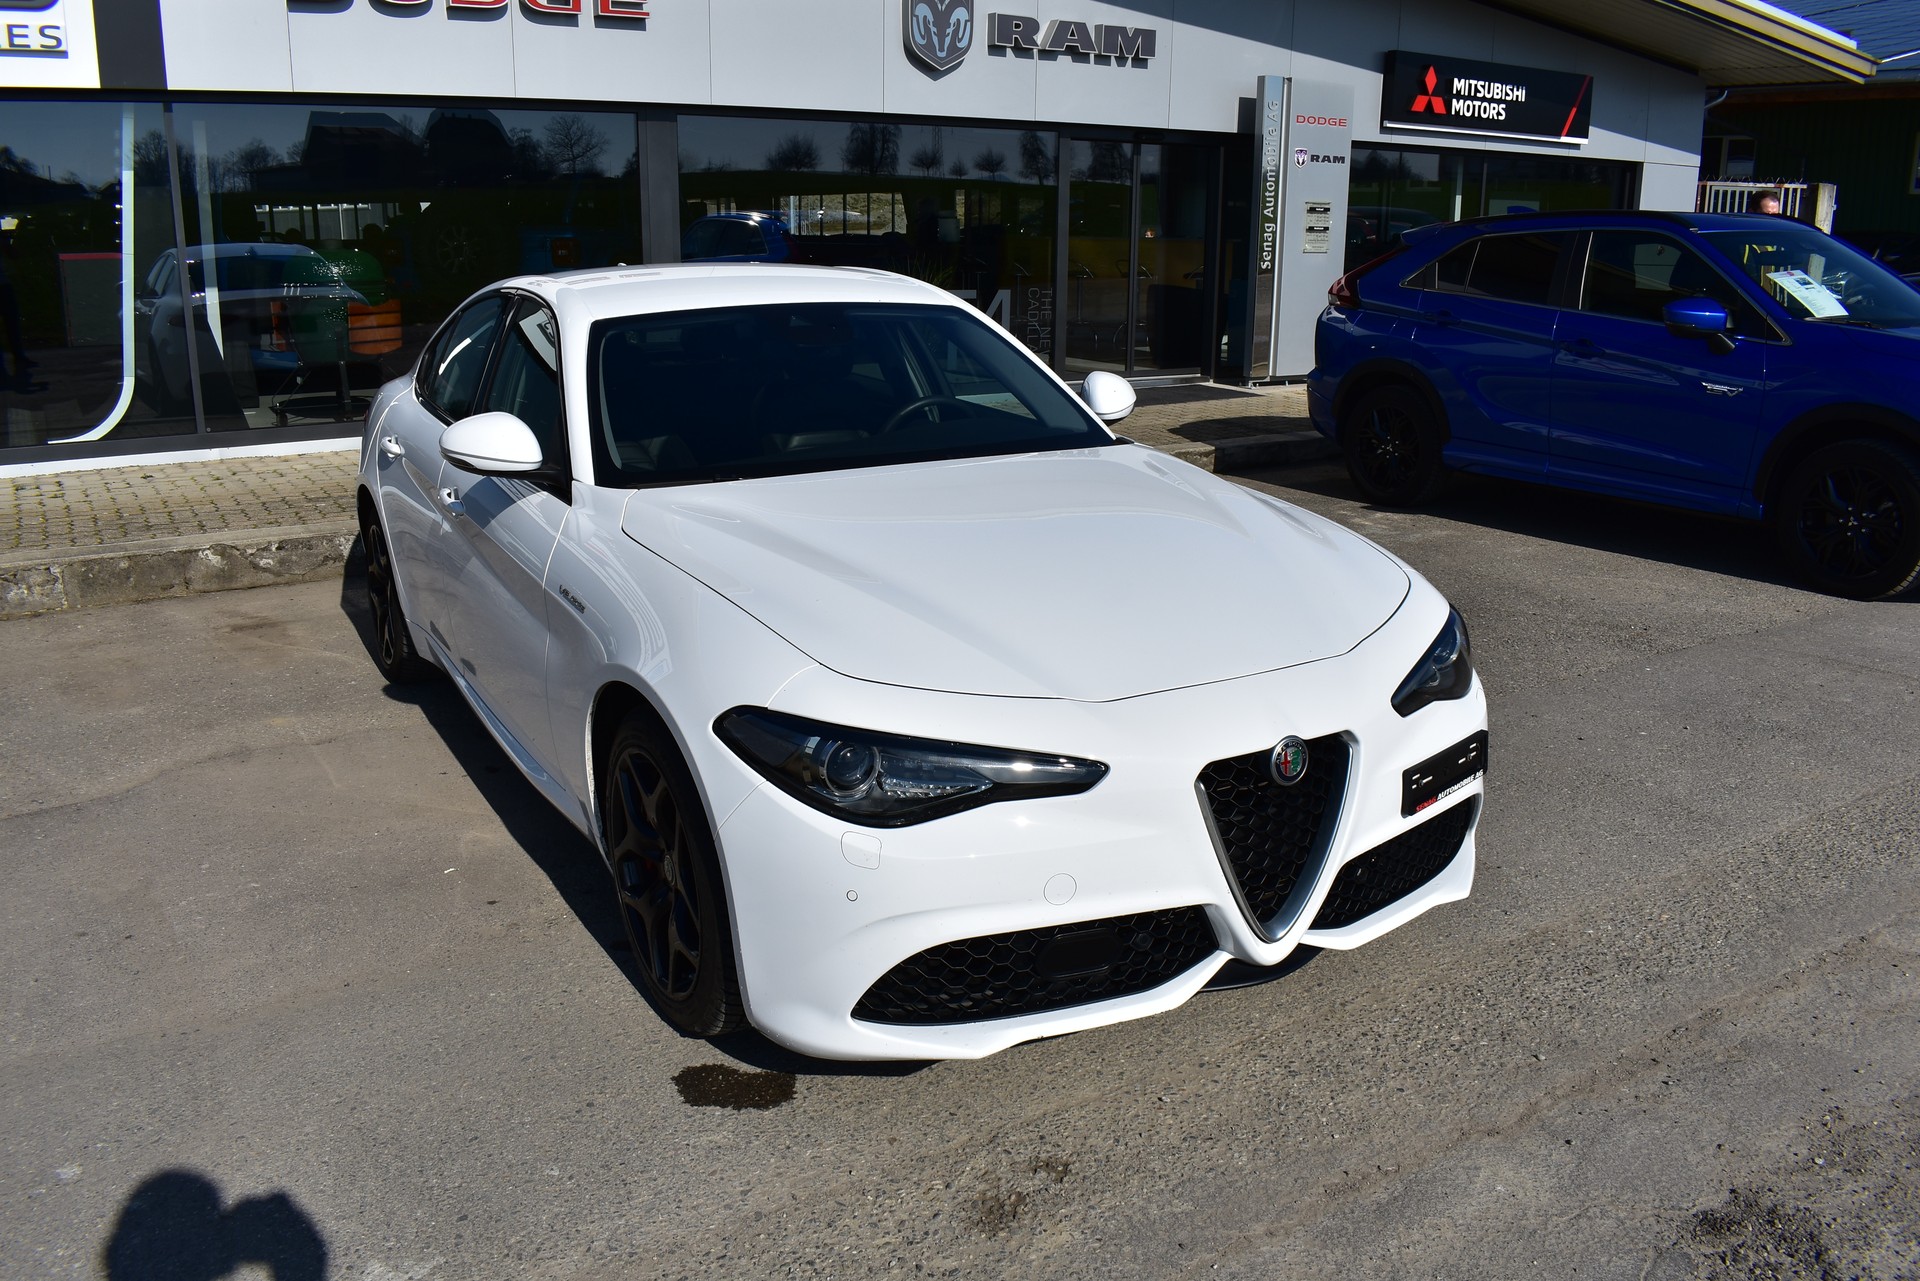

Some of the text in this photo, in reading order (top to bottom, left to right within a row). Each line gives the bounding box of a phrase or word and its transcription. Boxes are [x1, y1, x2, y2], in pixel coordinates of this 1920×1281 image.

[0, 24, 63, 49] ES
[988, 12, 1157, 59] RAM
[1453, 77, 1526, 102] MITSUBISHI
[1296, 114, 1348, 127] DODGE
[1451, 98, 1506, 121] MOTORS
[1310, 154, 1346, 164] RAM
[1260, 100, 1278, 270] Senag Automobile AG
[1041, 287, 1053, 319] THE
[1027, 287, 1040, 353] CADILLA
[1474, 769, 1484, 780] AG
